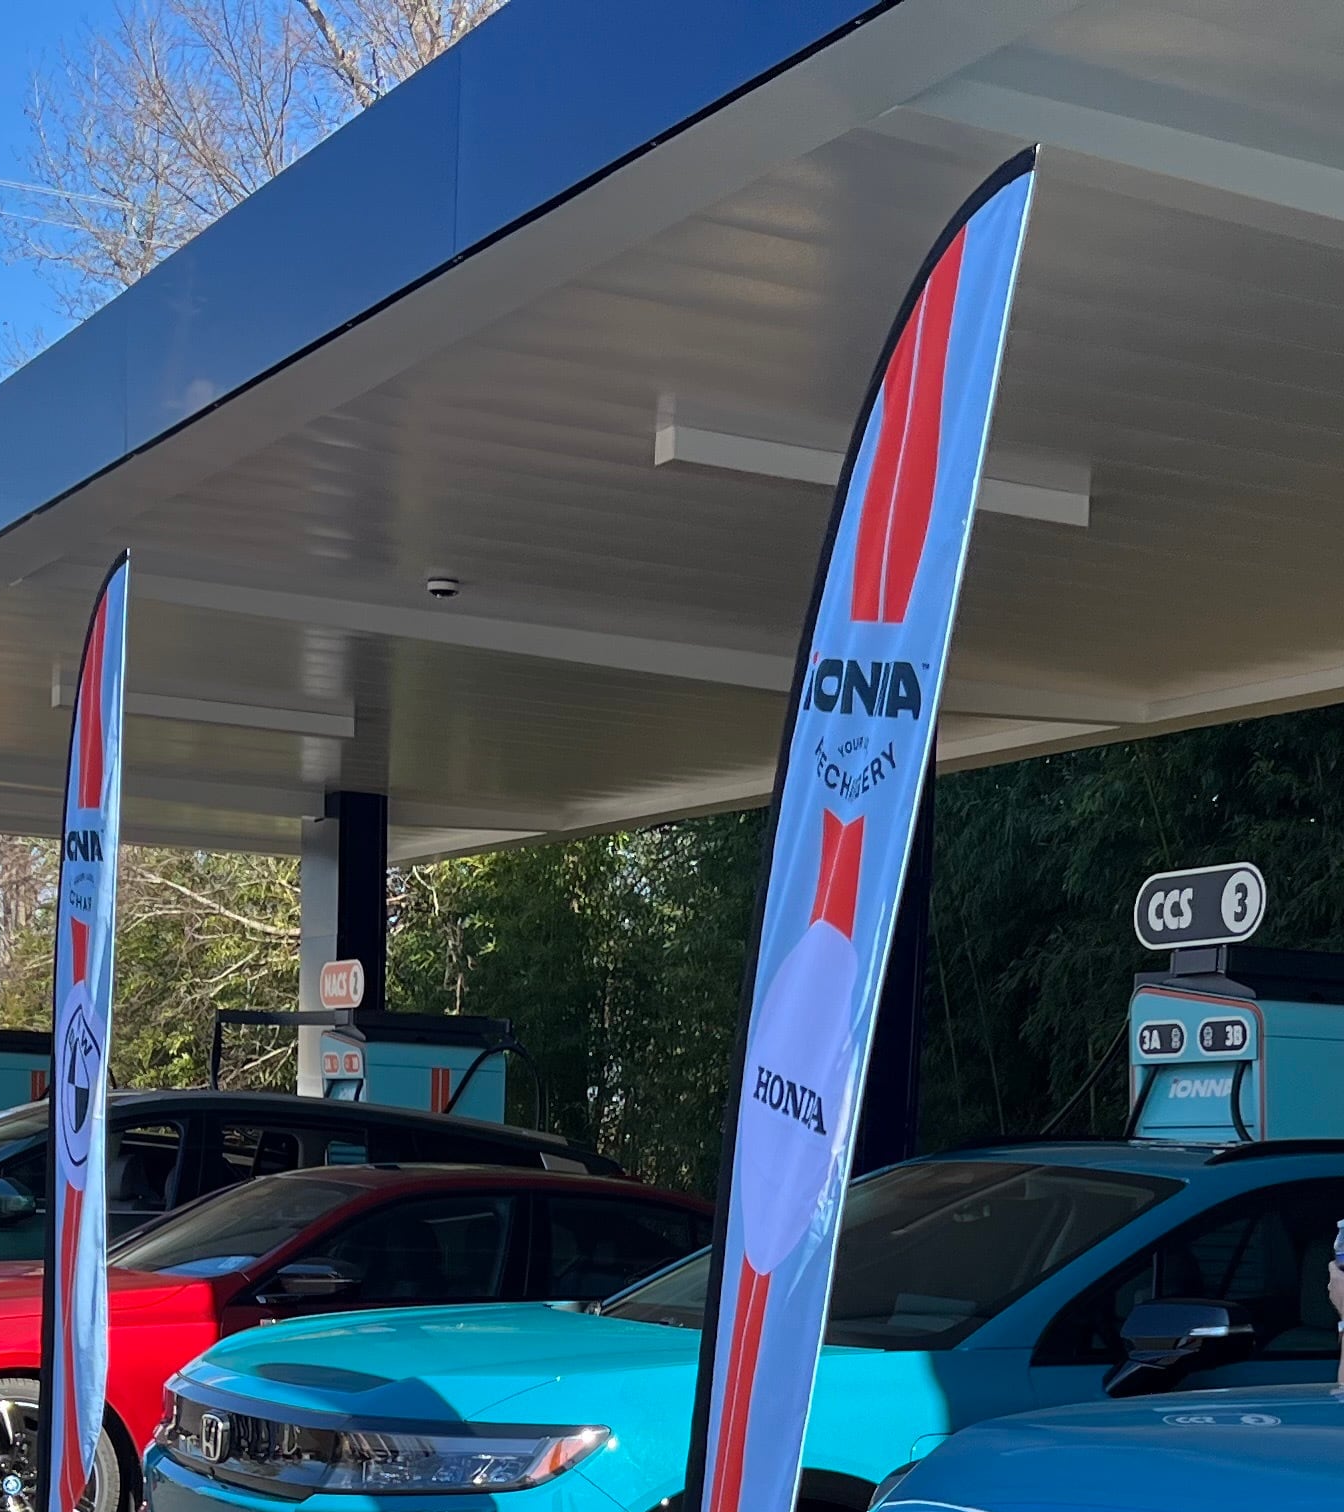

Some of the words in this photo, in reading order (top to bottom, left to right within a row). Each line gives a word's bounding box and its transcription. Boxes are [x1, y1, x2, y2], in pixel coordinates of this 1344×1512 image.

[1147, 888, 1193, 931] CCS
[1233, 883, 1248, 923] 3
[325, 973, 347, 997] NACS
[1142, 1030, 1160, 1051] 3A
